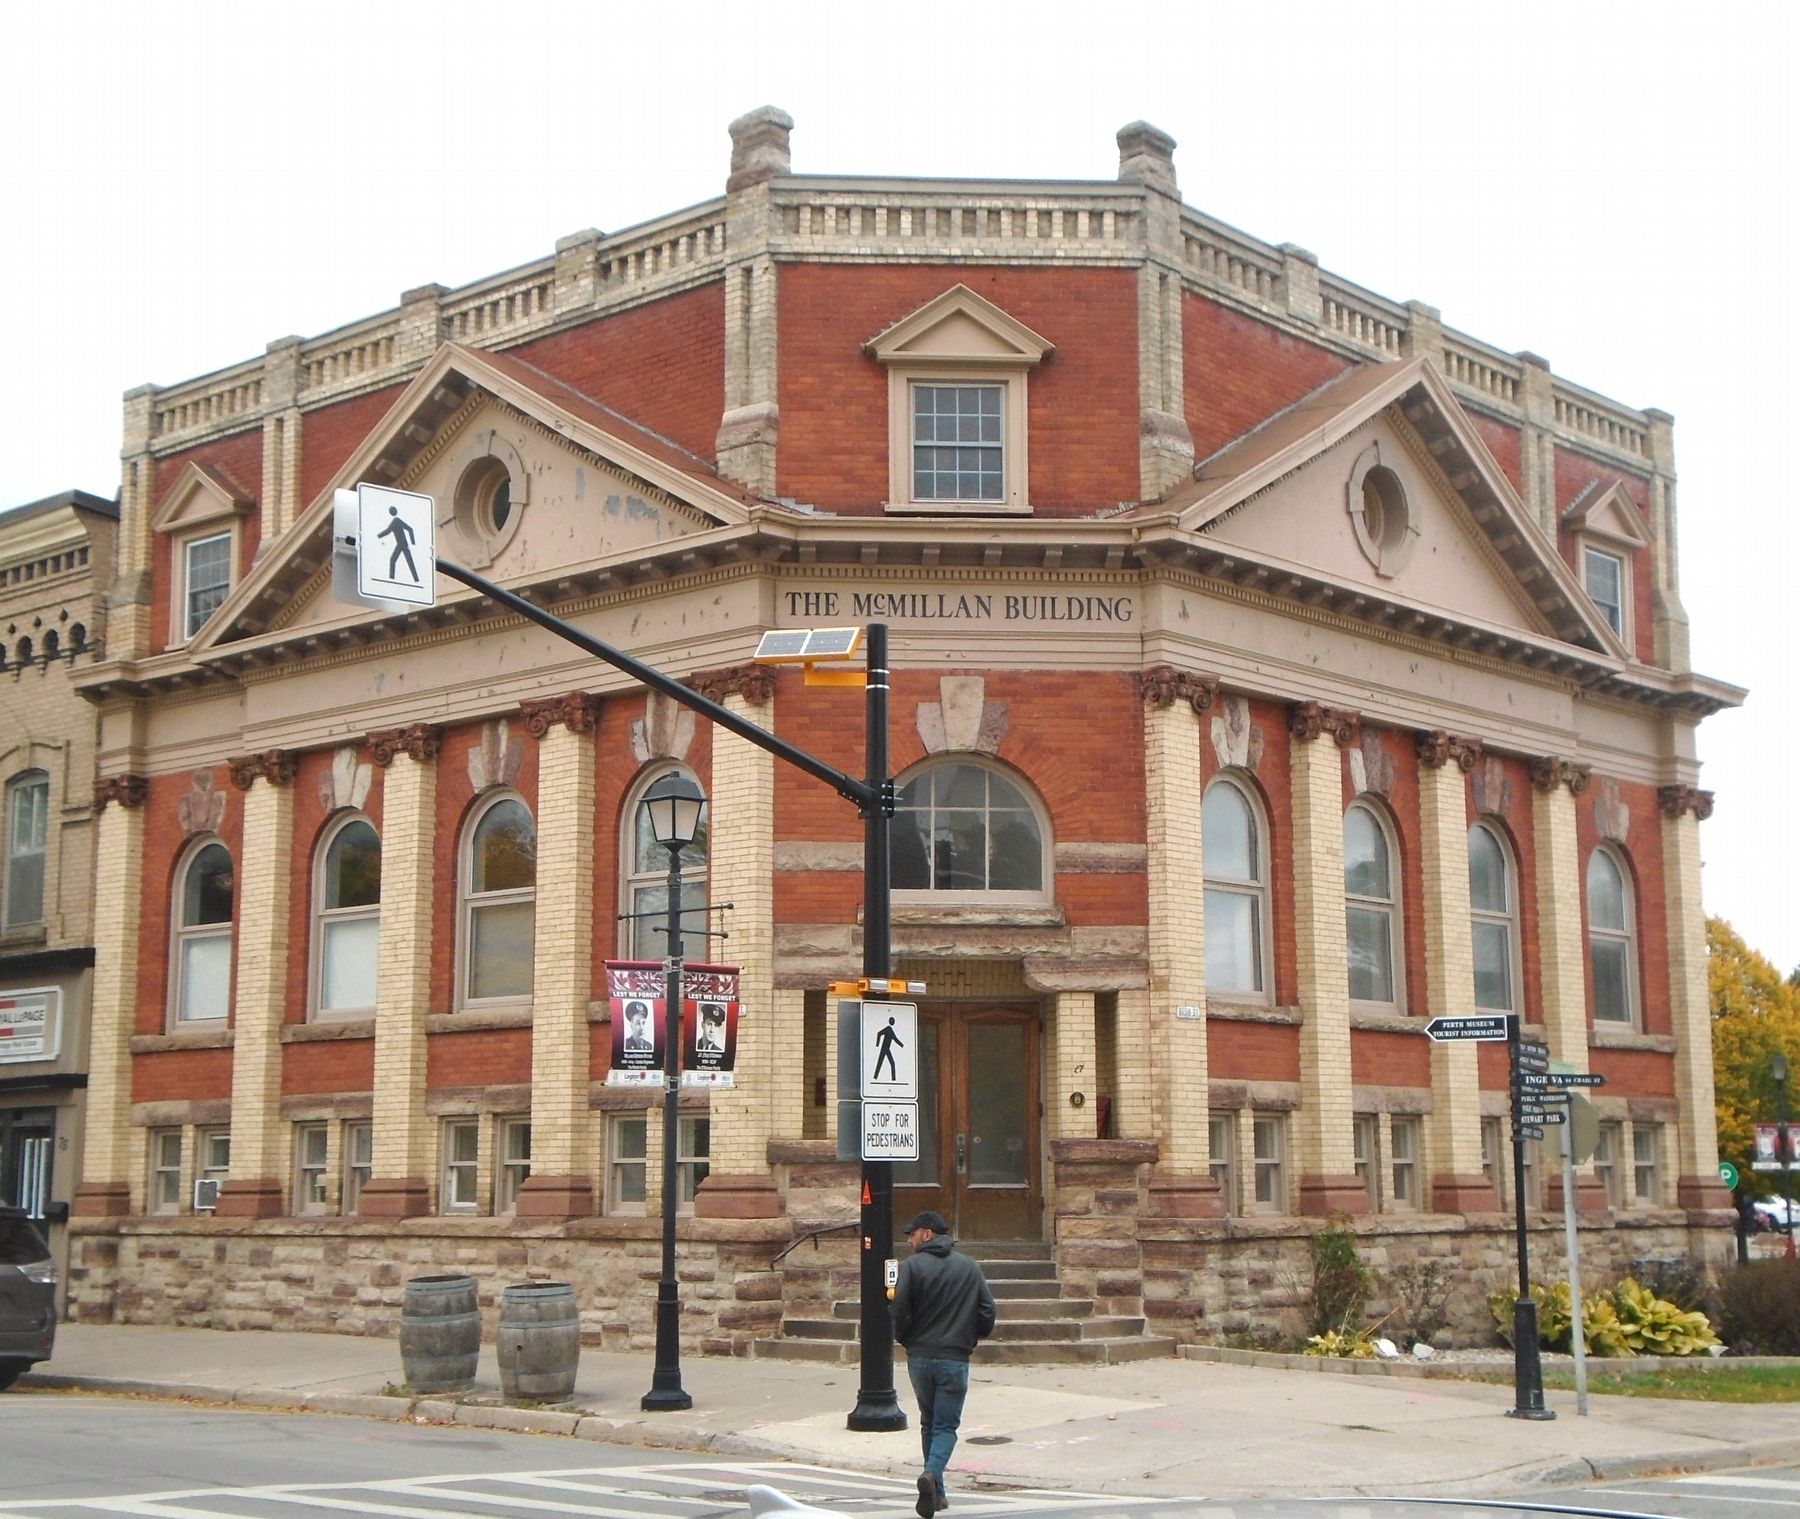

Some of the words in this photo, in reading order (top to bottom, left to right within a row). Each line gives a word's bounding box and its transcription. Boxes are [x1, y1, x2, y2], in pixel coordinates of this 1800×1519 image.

[785, 592, 840, 617] THE
[1003, 595, 1133, 622] BUILDING
[1442, 1021, 1464, 1029] PERTH
[1466, 1020, 1495, 1028] MUSEUM
[1461, 1029, 1505, 1037] INFORMATION
[1526, 1075, 1548, 1084] INGE
[1552, 1076, 1563, 1084] VA
[871, 1112, 890, 1128] STOP
[895, 1113, 909, 1128] FOR
[1521, 1115, 1544, 1124] STEWART
[1546, 1114, 1560, 1123] PARK
[866, 1133, 914, 1148] PEDESTRIANS
